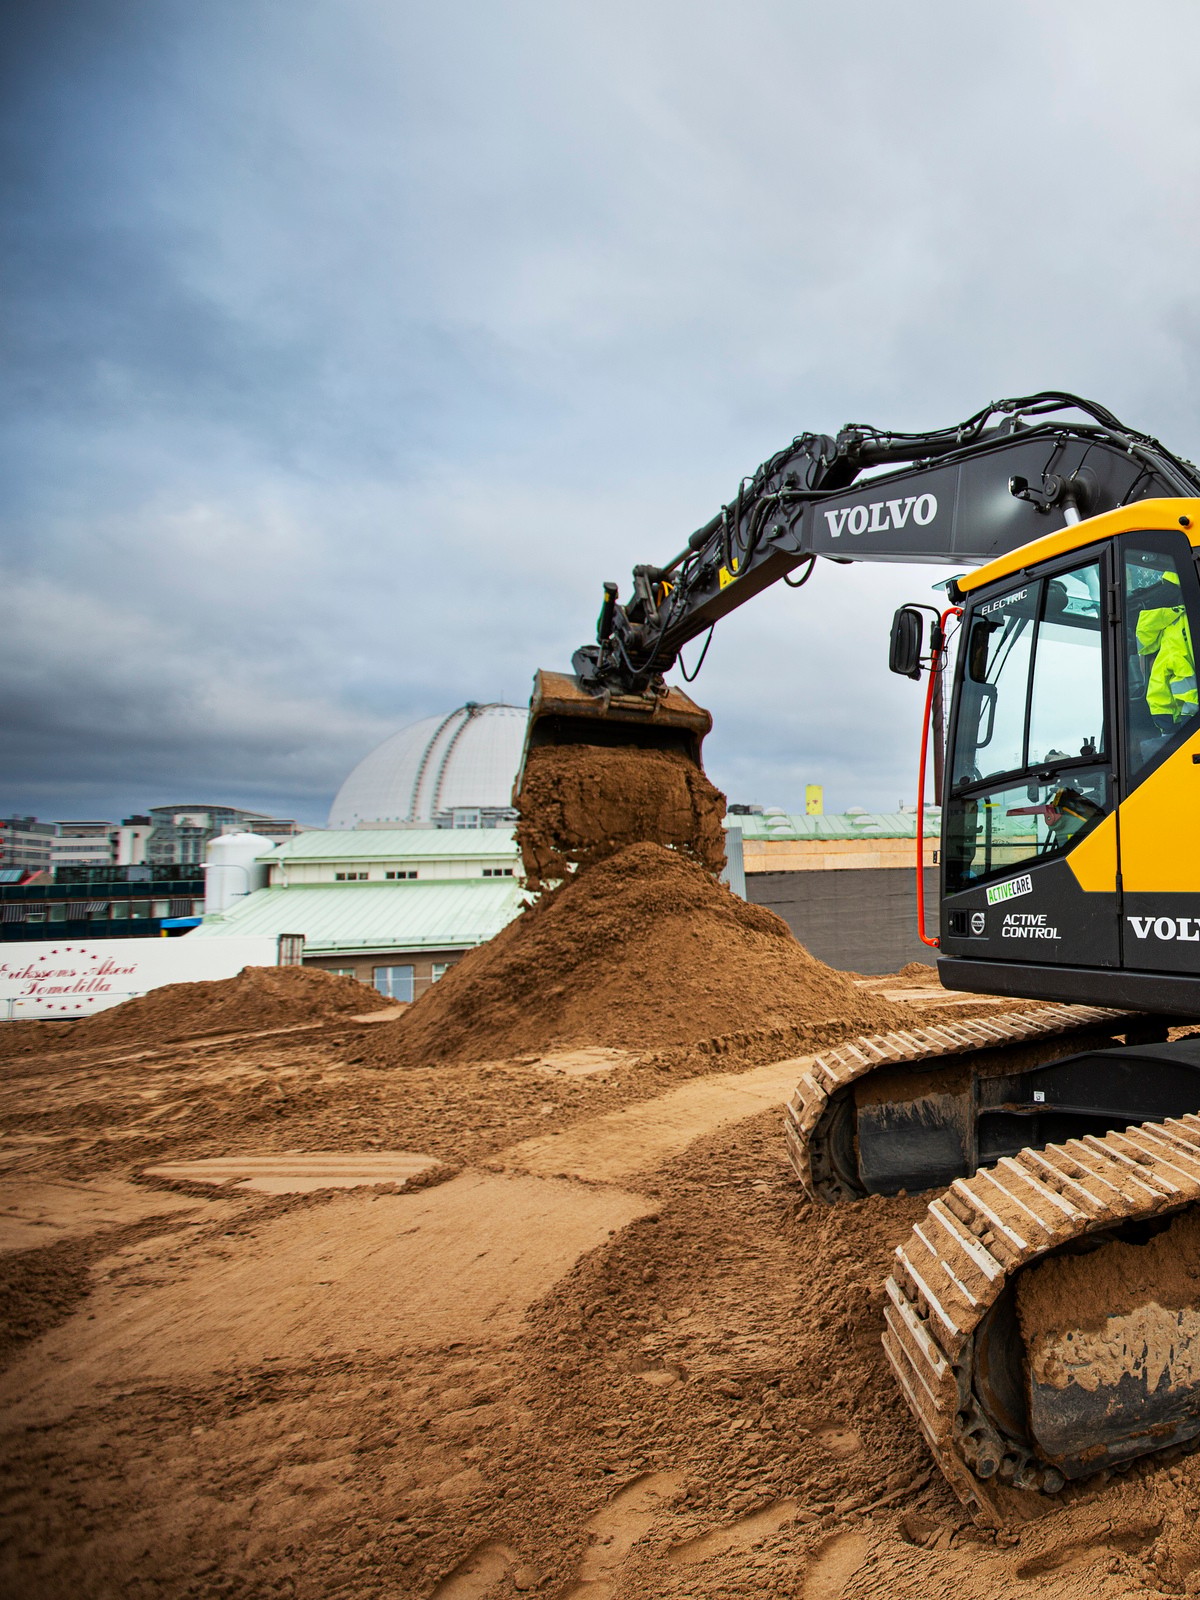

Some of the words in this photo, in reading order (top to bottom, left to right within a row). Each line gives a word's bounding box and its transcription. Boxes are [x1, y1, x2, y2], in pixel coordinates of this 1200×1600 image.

[824, 493, 938, 538] VOLVO
[981, 589, 1028, 616] ELECTRIC
[988, 876, 1031, 903] ACTIVECARE
[1002, 926, 1062, 940] CONTROL
[1003, 914, 1047, 926] ACTIVE
